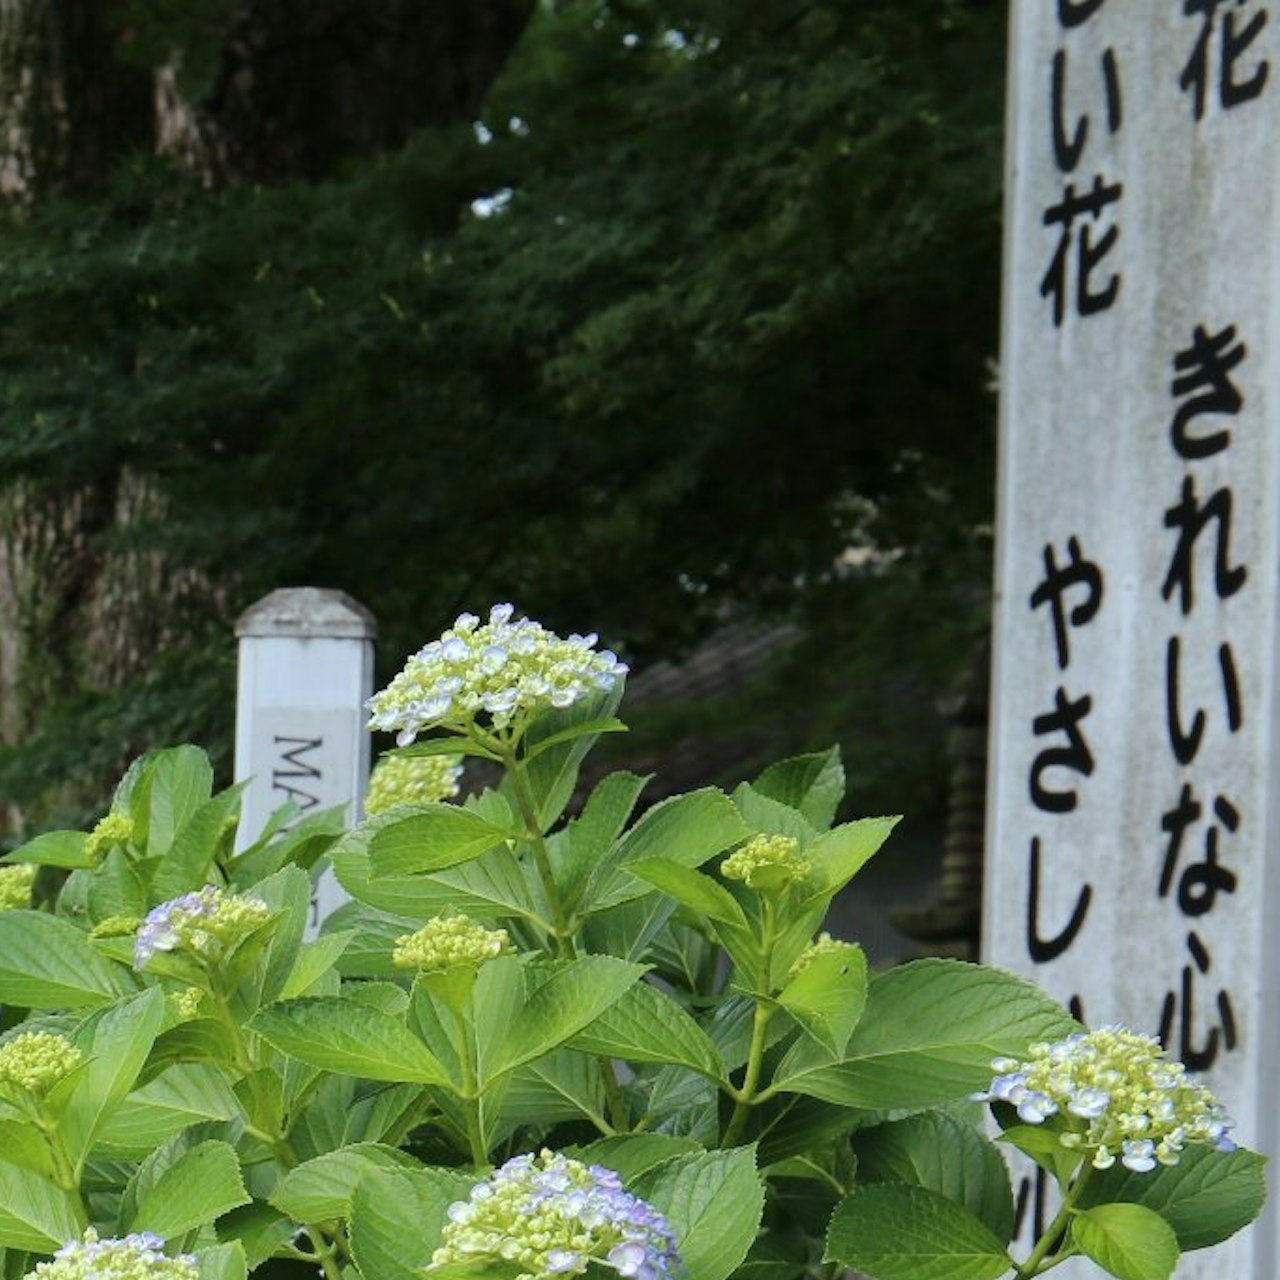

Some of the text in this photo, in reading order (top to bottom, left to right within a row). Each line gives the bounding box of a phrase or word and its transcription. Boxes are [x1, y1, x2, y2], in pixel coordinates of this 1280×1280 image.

[1041, 0, 1124, 328] い花
[1159, 0, 1270, 1072] 花 きれいな心
